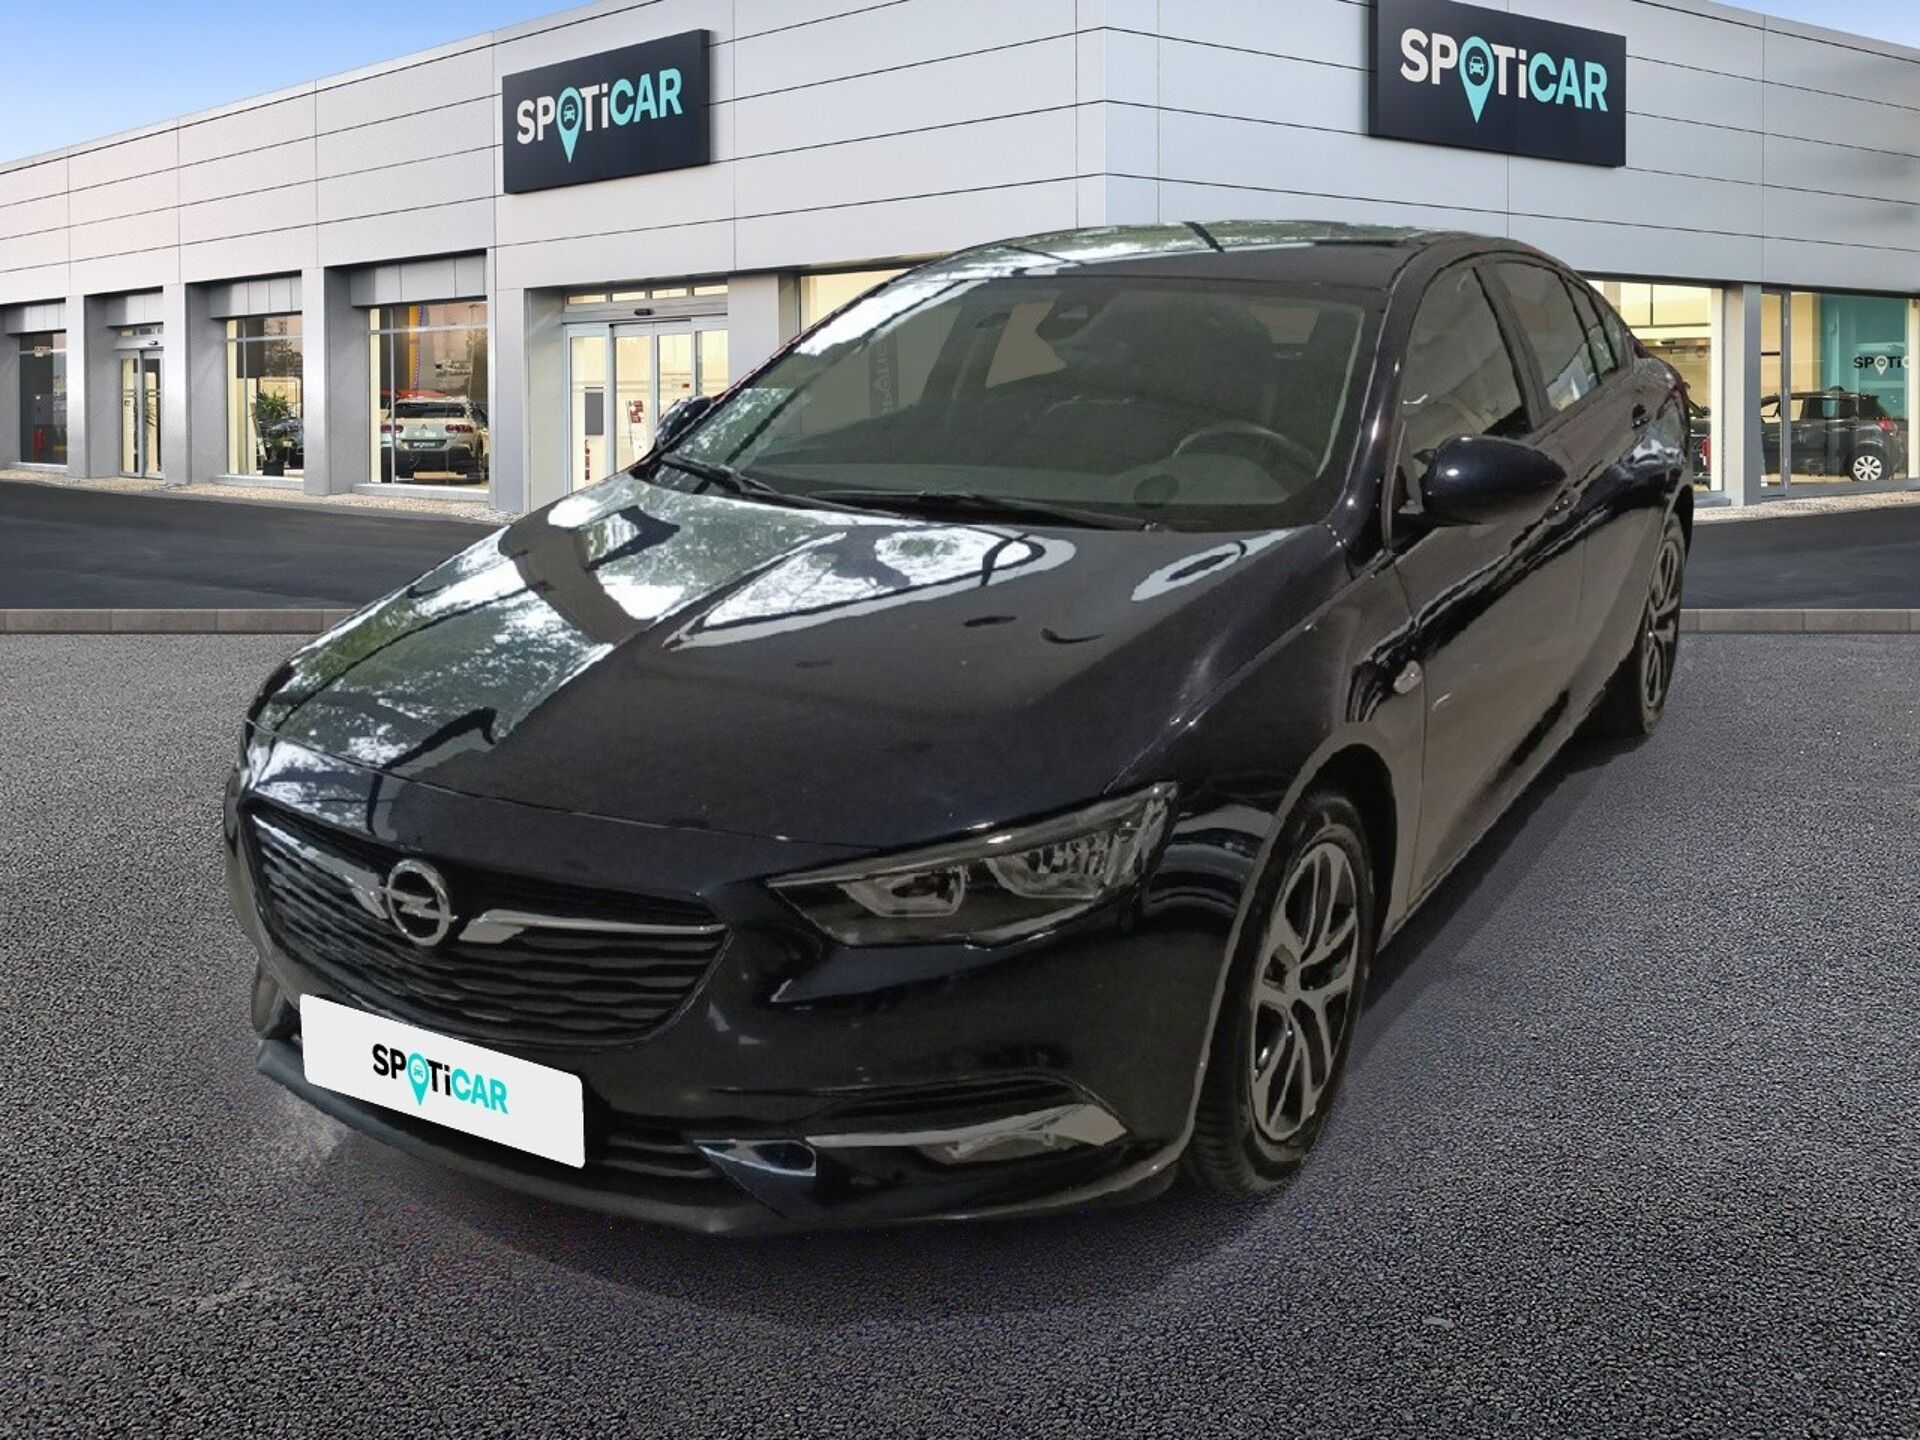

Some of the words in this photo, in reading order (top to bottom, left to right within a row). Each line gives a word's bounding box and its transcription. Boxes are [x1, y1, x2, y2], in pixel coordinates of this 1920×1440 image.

[517, 68, 683, 163] SPOTiCAR
[1400, 28, 1608, 124] SPOTiCAR
[372, 1043, 509, 1114] SPOTiCAR
